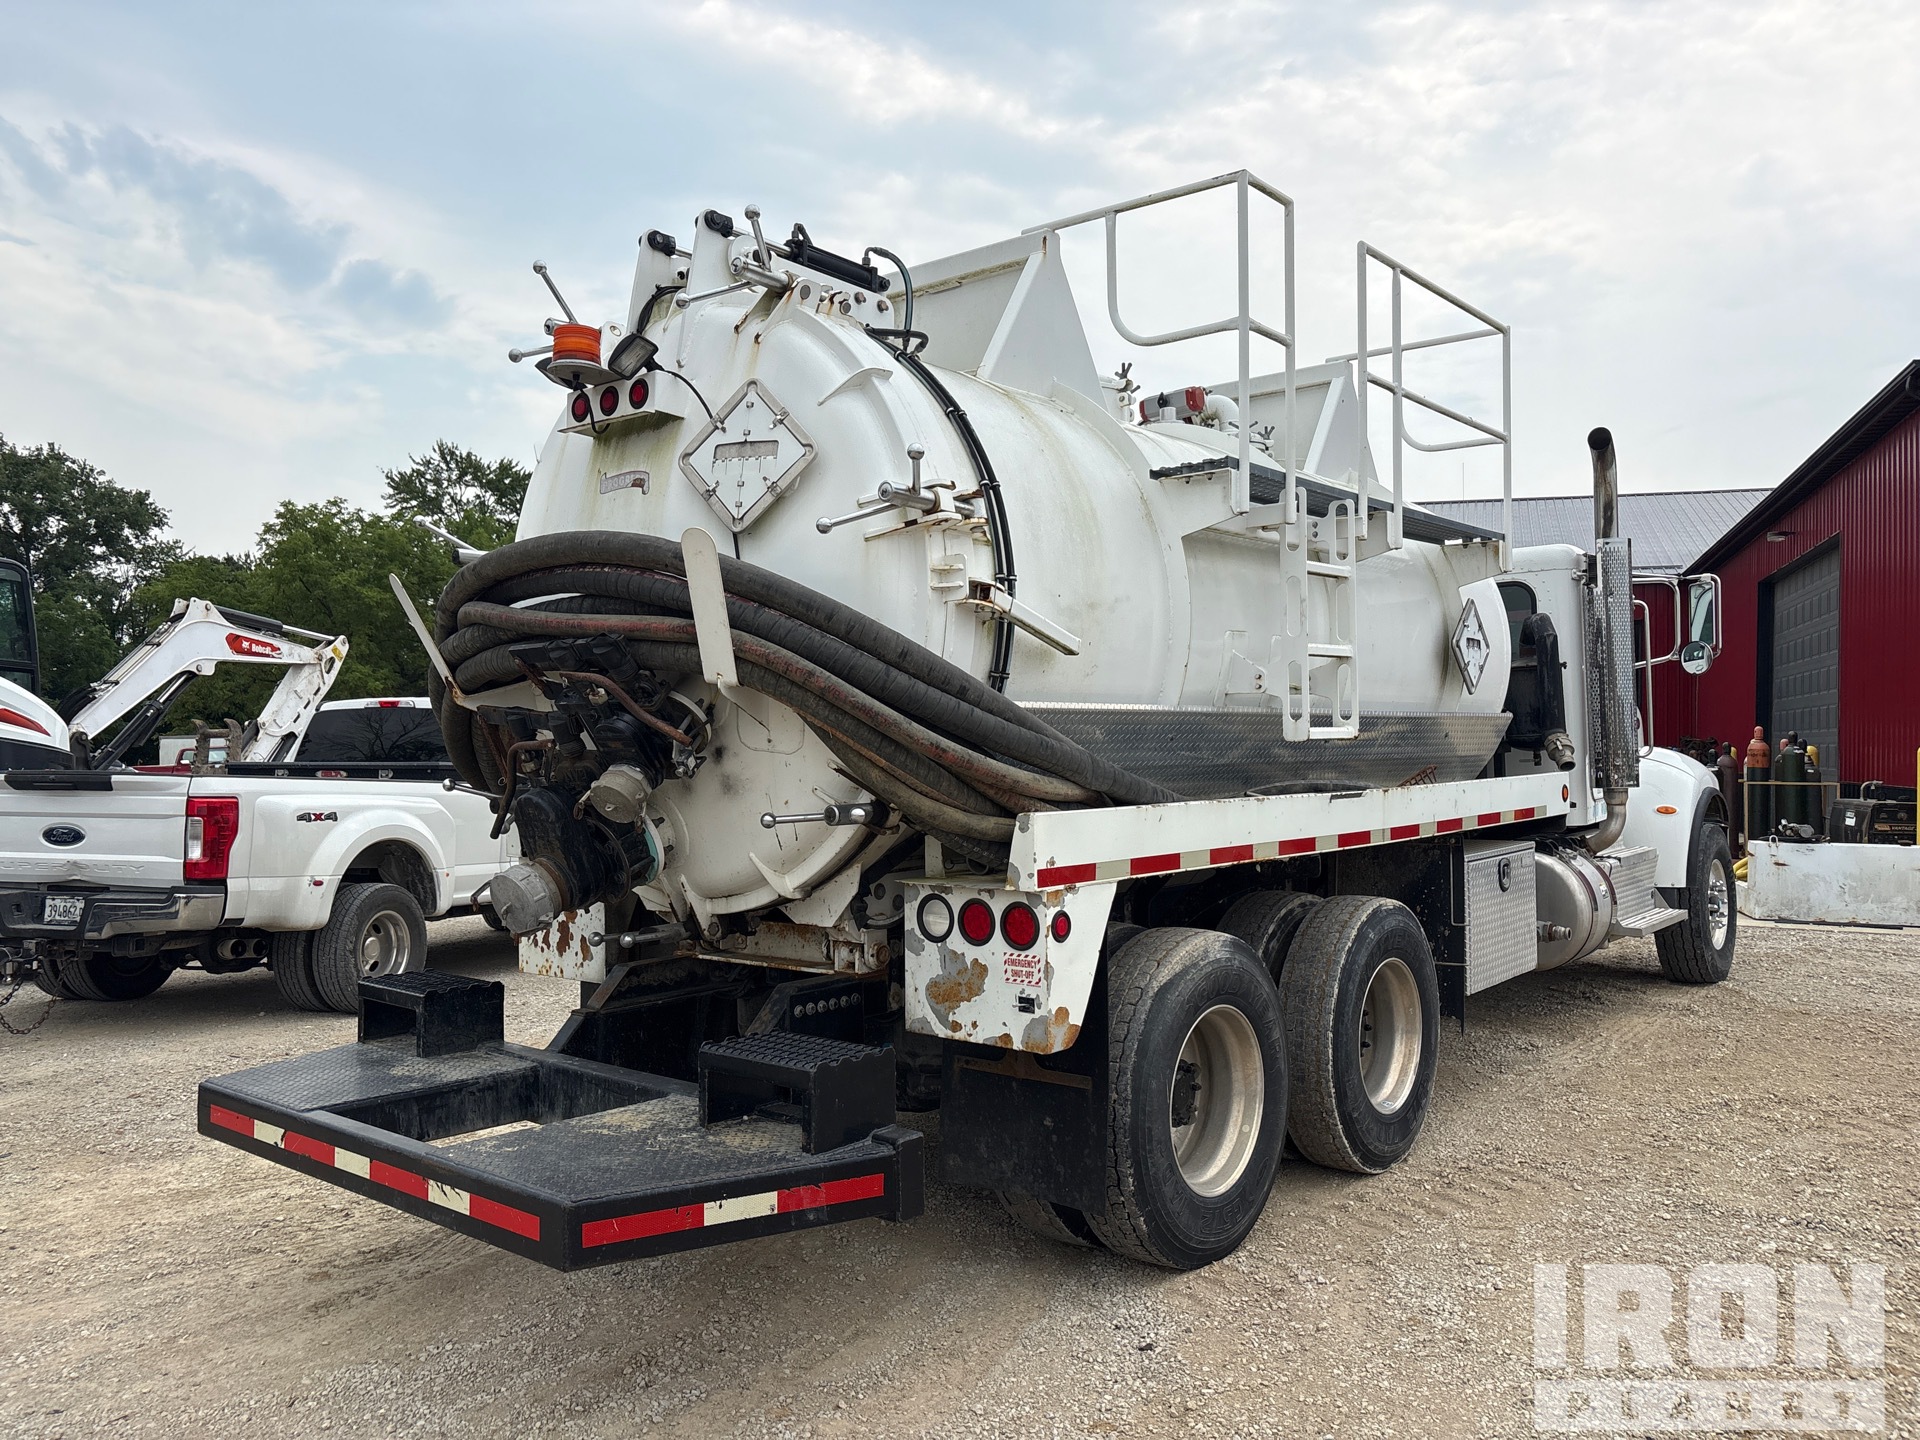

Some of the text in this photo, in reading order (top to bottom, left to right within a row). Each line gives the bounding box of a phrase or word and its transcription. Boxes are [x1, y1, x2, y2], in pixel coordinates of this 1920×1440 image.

[601, 474, 647, 492] PROGR
[251, 643, 272, 654] Bobcat
[51, 828, 75, 842] Ford
[0, 860, 68, 871] UPER
[1007, 957, 1037, 969] EMERGENCY
[1010, 968, 1034, 979] SHUT-OFF
